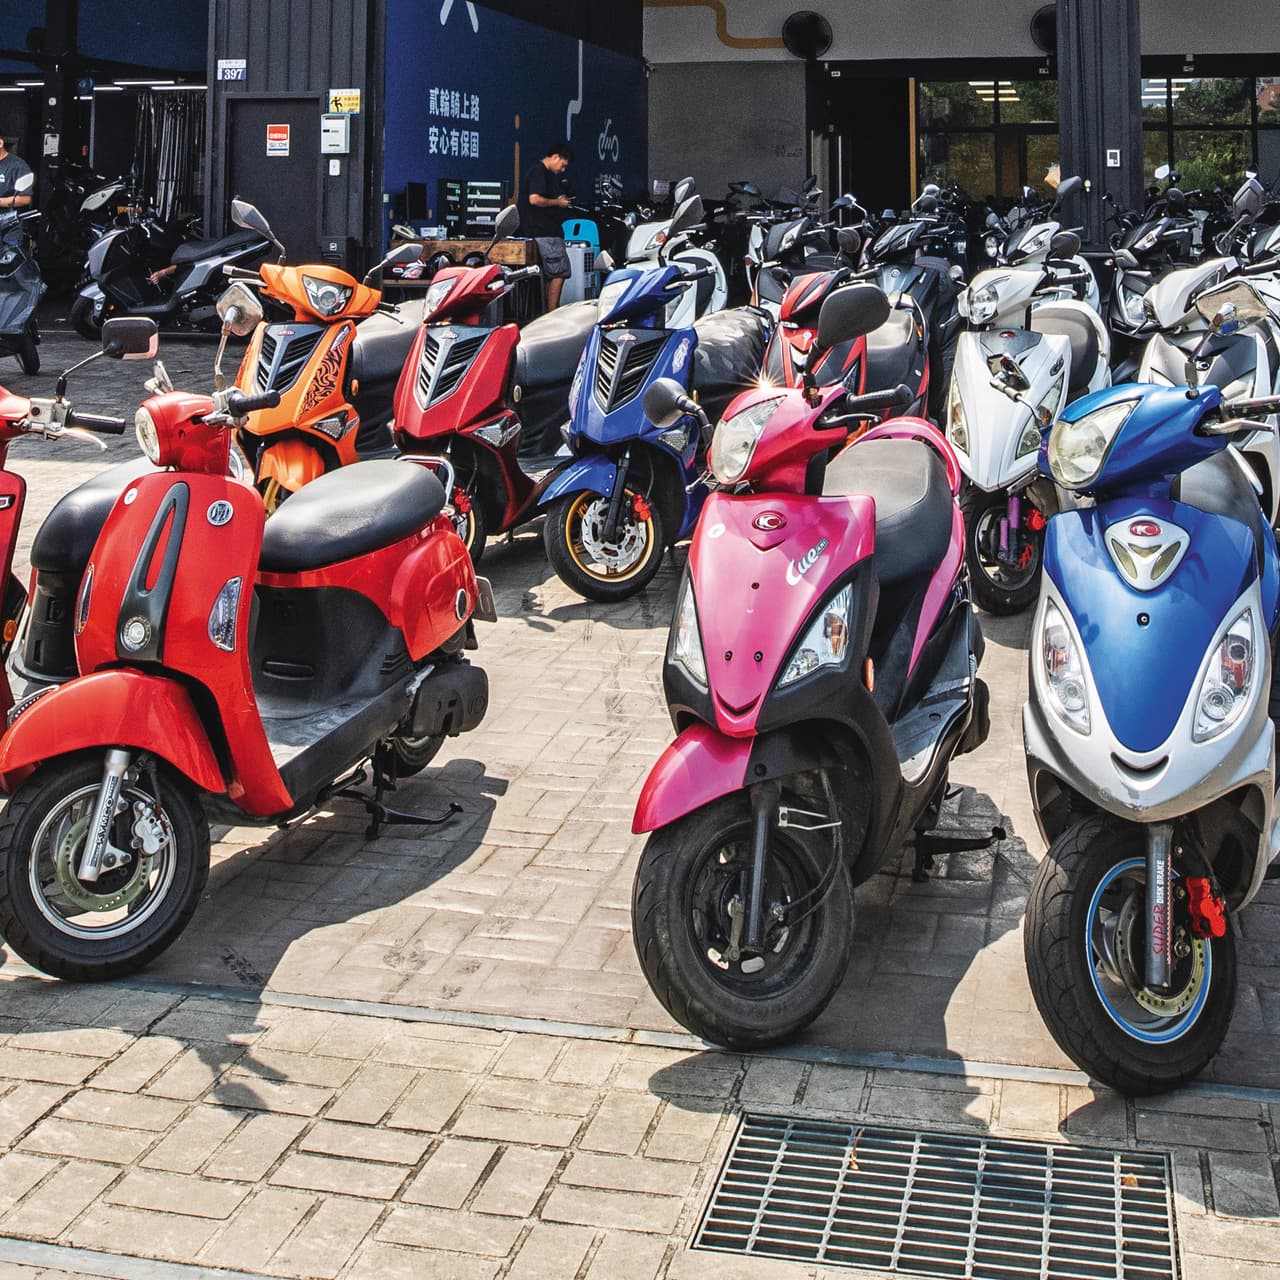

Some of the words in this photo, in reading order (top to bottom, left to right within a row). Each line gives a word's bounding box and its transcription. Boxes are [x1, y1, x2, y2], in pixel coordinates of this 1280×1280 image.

[224, 68, 243, 80] 397
[429, 87, 480, 122] 貳輪騎上路
[428, 125, 480, 158] 安心有保固
[95, 797, 113, 846] KYMCO
[1156, 859, 1165, 885] BRAKE
